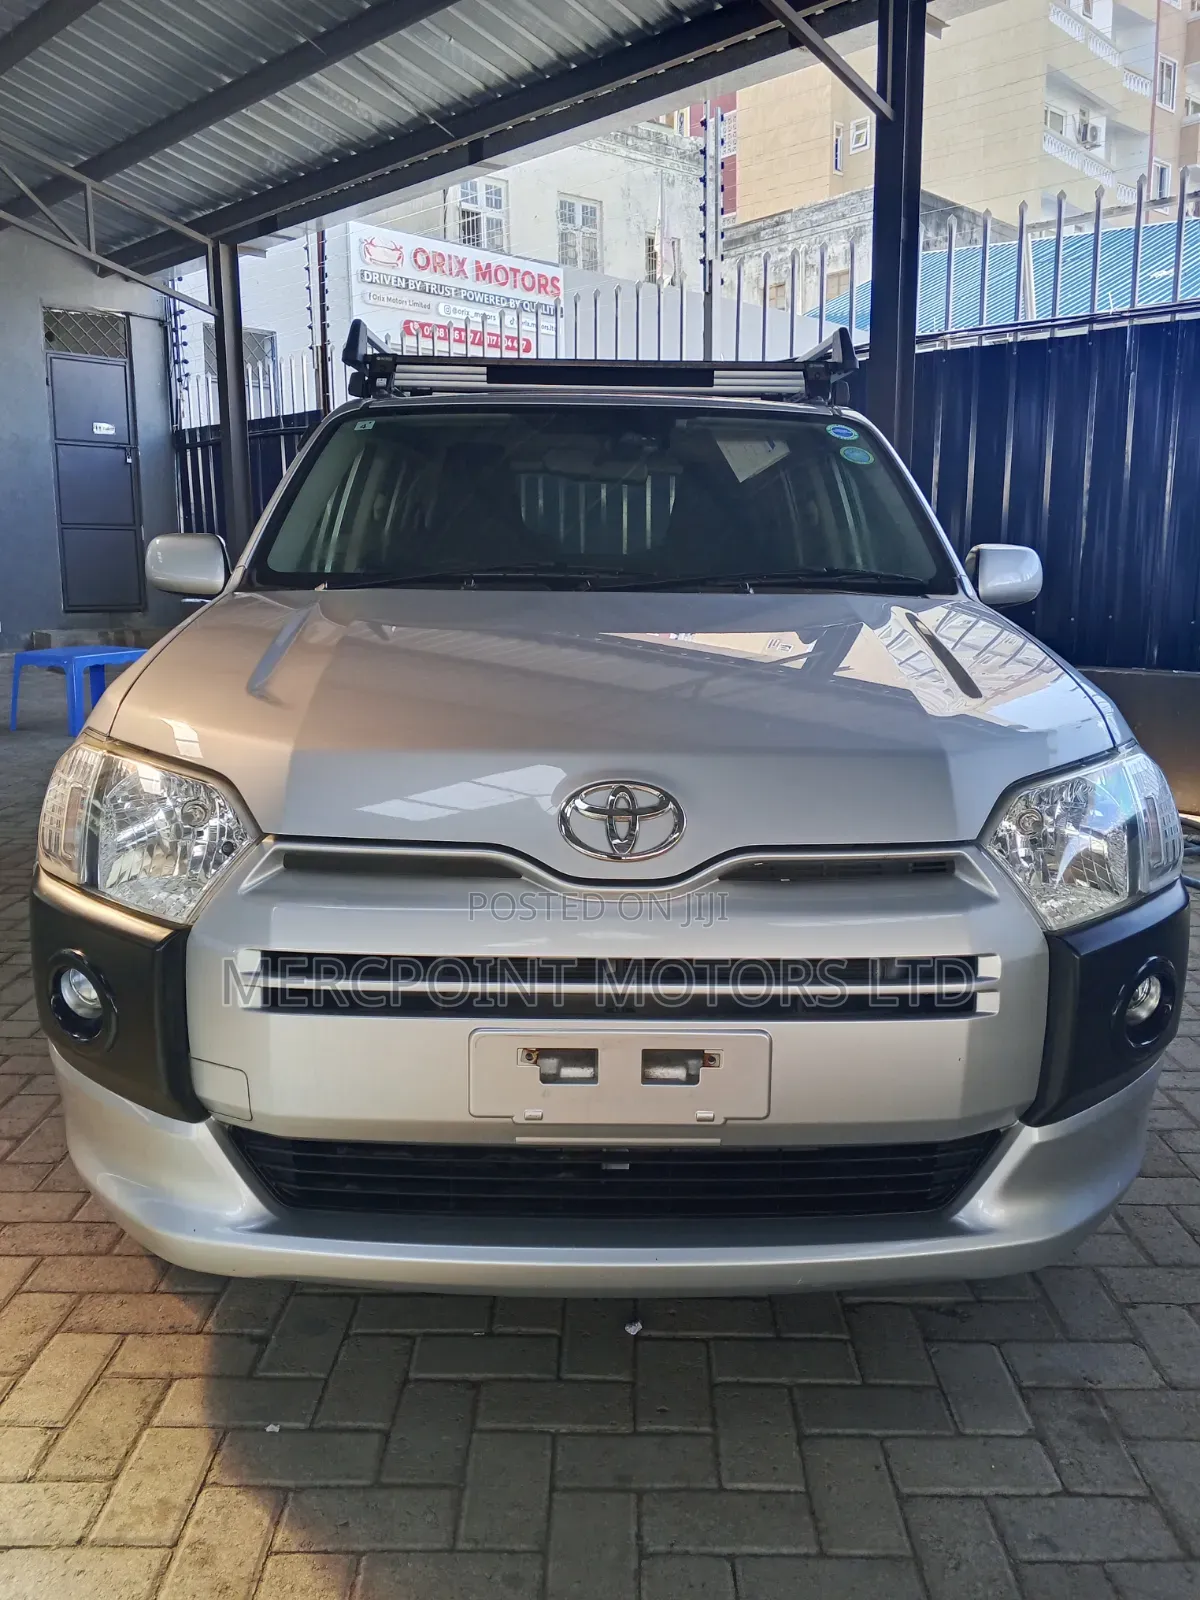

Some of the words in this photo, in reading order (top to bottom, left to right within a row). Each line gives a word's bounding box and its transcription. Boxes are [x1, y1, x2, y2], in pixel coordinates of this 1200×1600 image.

[364, 271, 405, 288] DRIVEN
[408, 279, 421, 290] BY
[424, 283, 457, 297] TRUST
[461, 289, 508, 307] POWERED
[509, 298, 521, 309] BY
[522, 301, 557, 316] QULIT
[413, 247, 469, 279] ORIX
[475, 260, 561, 297] MOTORS
[372, 293, 386, 302] Orix
[387, 295, 407, 306] Motors
[408, 300, 431, 310] Limited
